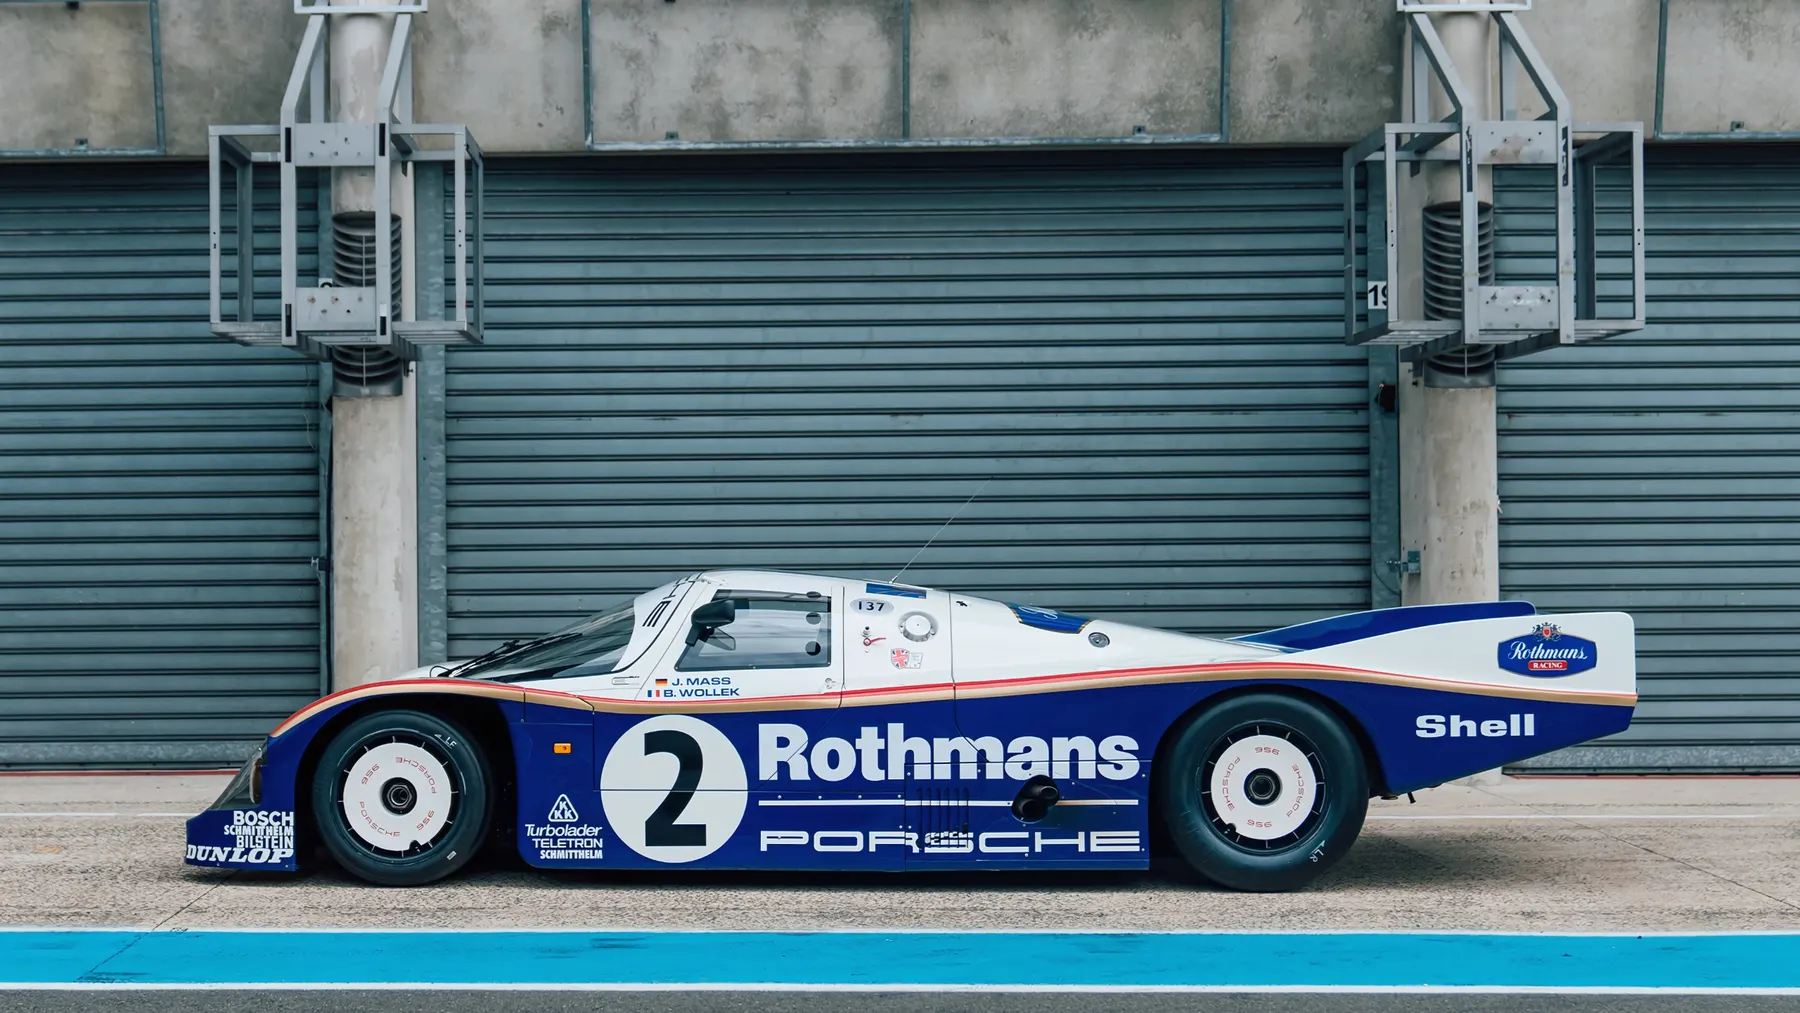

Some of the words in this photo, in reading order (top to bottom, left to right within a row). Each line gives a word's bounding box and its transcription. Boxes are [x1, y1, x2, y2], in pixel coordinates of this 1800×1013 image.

[858, 600, 886, 612] 137
[1507, 641, 1588, 660] Rothmans
[672, 678, 683, 686] J.
[686, 677, 731, 686] MASS
[663, 689, 677, 698] B.
[679, 688, 740, 697] WOLLEK
[1415, 713, 1535, 738] Shell
[758, 722, 1140, 782] Rothmans
[1254, 746, 1281, 756] 956
[395, 756, 438, 795] PORSCHE
[643, 730, 707, 847] 2
[1221, 756, 1241, 812] PORSCHE
[233, 810, 295, 827] BOSCH
[359, 801, 401, 837] PORSCHE
[1247, 818, 1273, 828] 956
[223, 824, 295, 836] SCHMITTHELM
[524, 823, 603, 837] Turbolader
[236, 835, 294, 849] BILSTEIN
[531, 838, 603, 849] TELETRON
[759, 830, 1140, 853] PORSCHE
[185, 844, 294, 864] DUNLOP
[540, 849, 603, 860] SCHMITTHELM
